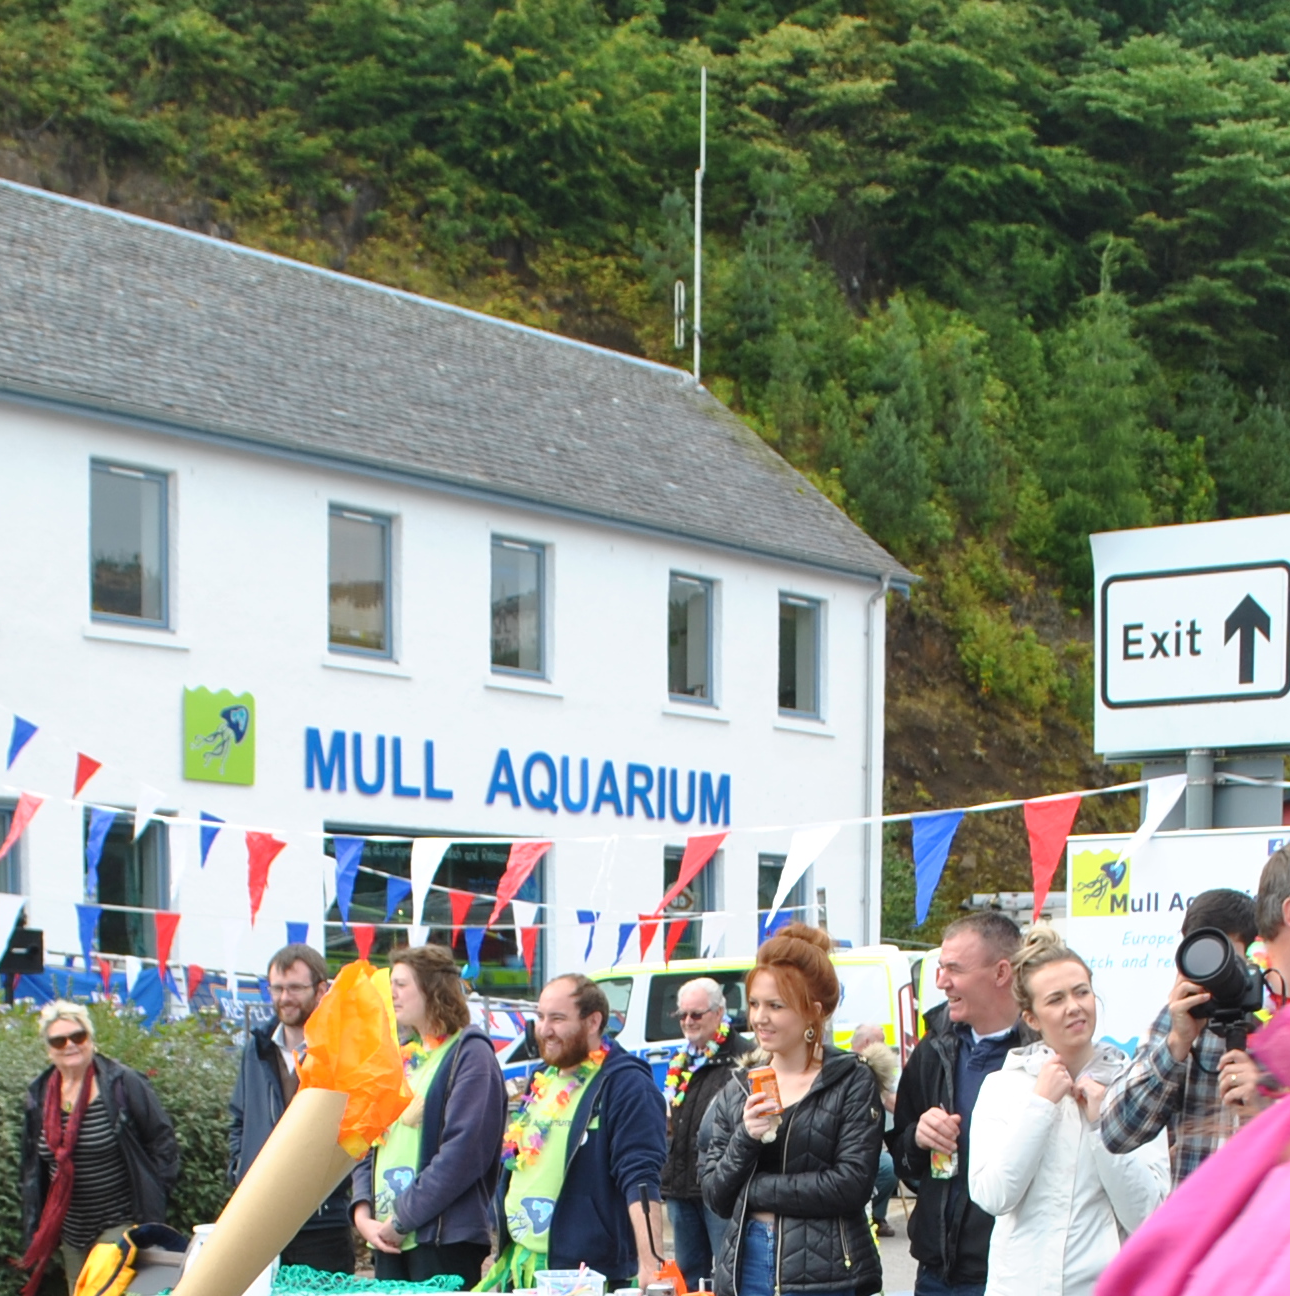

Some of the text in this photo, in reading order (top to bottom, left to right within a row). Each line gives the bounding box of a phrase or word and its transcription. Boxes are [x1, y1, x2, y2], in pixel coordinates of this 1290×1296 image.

[1122, 618, 1202, 661] Exit
[304, 726, 731, 827] MULL AQUARIUM
[1109, 892, 1158, 913] Mull
[1122, 953, 1149, 968] and
